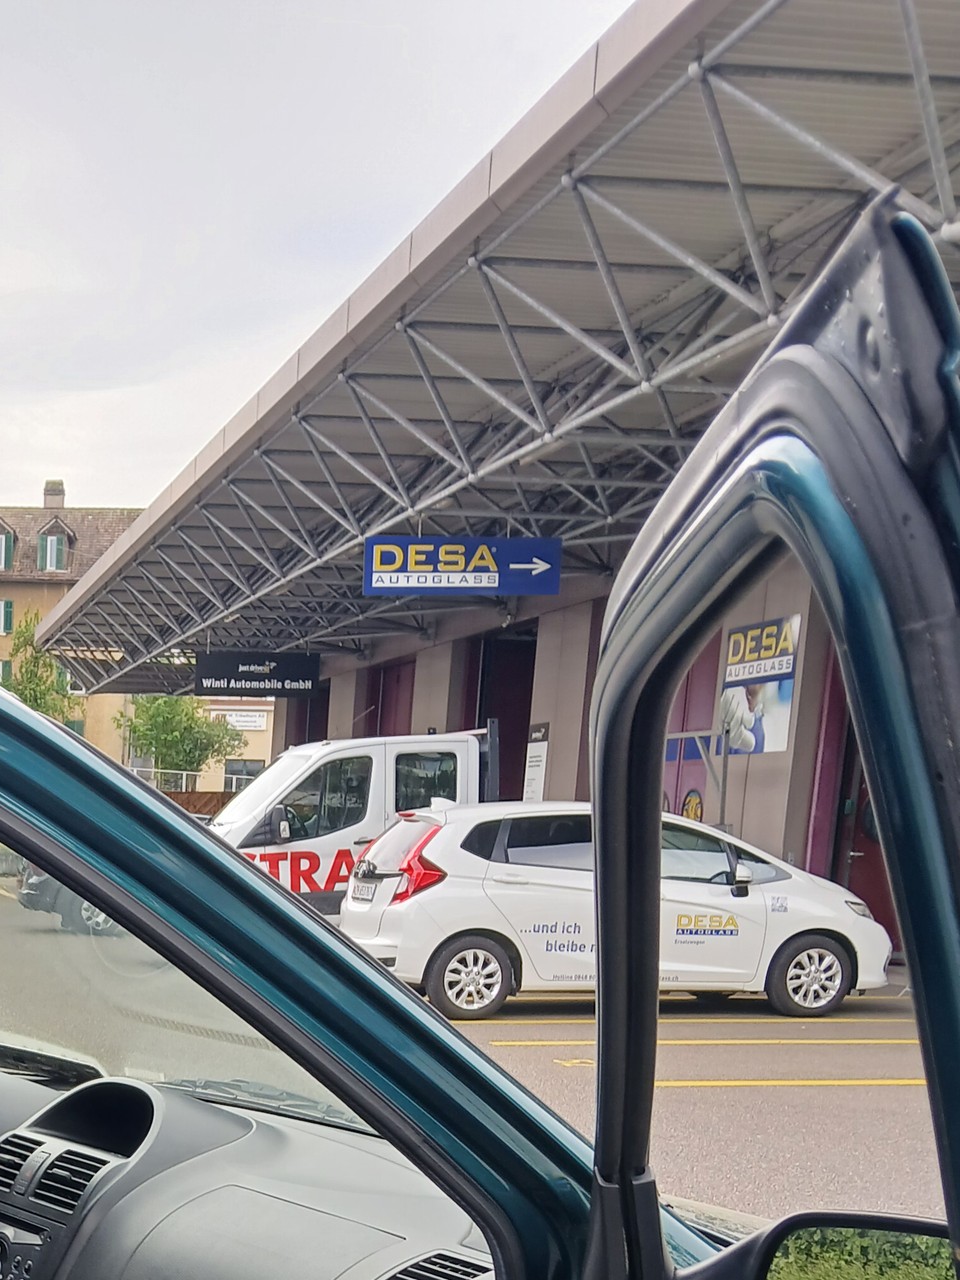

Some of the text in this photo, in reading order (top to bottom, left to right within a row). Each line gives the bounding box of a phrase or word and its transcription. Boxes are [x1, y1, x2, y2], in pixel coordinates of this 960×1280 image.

[373, 544, 498, 572] DESA
[375, 575, 497, 584] AUTOGLASS
[728, 623, 793, 664] DESA
[728, 659, 791, 678] AUTOGLASS
[202, 678, 312, 689] Winti Automobile GmbH
[243, 849, 355, 892] TRA
[562, 922, 581, 934] ich
[676, 914, 739, 928] DESA
[545, 940, 586, 953] bleibe
